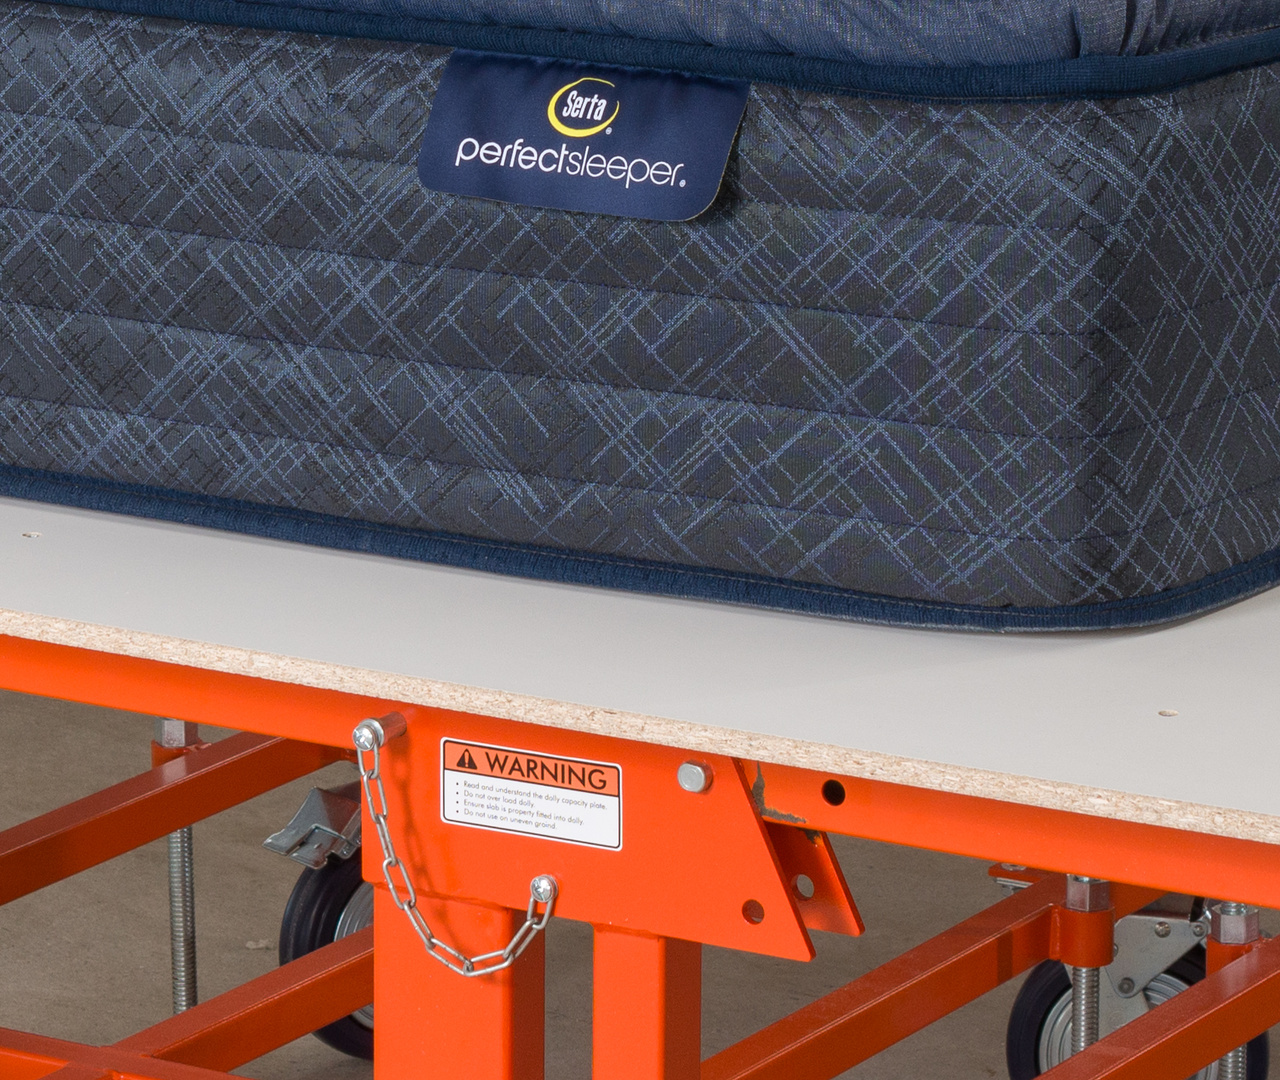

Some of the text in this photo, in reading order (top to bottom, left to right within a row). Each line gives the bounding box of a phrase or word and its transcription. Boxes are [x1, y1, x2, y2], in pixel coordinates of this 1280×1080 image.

[562, 90, 607, 121] Serta
[485, 752, 607, 790] WARNING
[463, 780, 480, 789] Read
[495, 787, 531, 797] understand
[532, 792, 543, 800] the
[544, 794, 560, 803] dolly
[561, 798, 588, 808] capacity
[589, 801, 608, 810] plate.
[502, 796, 517, 804] load
[518, 799, 535, 808] dolly.
[463, 799, 485, 808] Ensure
[486, 802, 500, 811] slab
[553, 813, 566, 822] into
[567, 816, 584, 826] dolly.
[463, 808, 474, 816] Do
[510, 817, 533, 825] uneven
